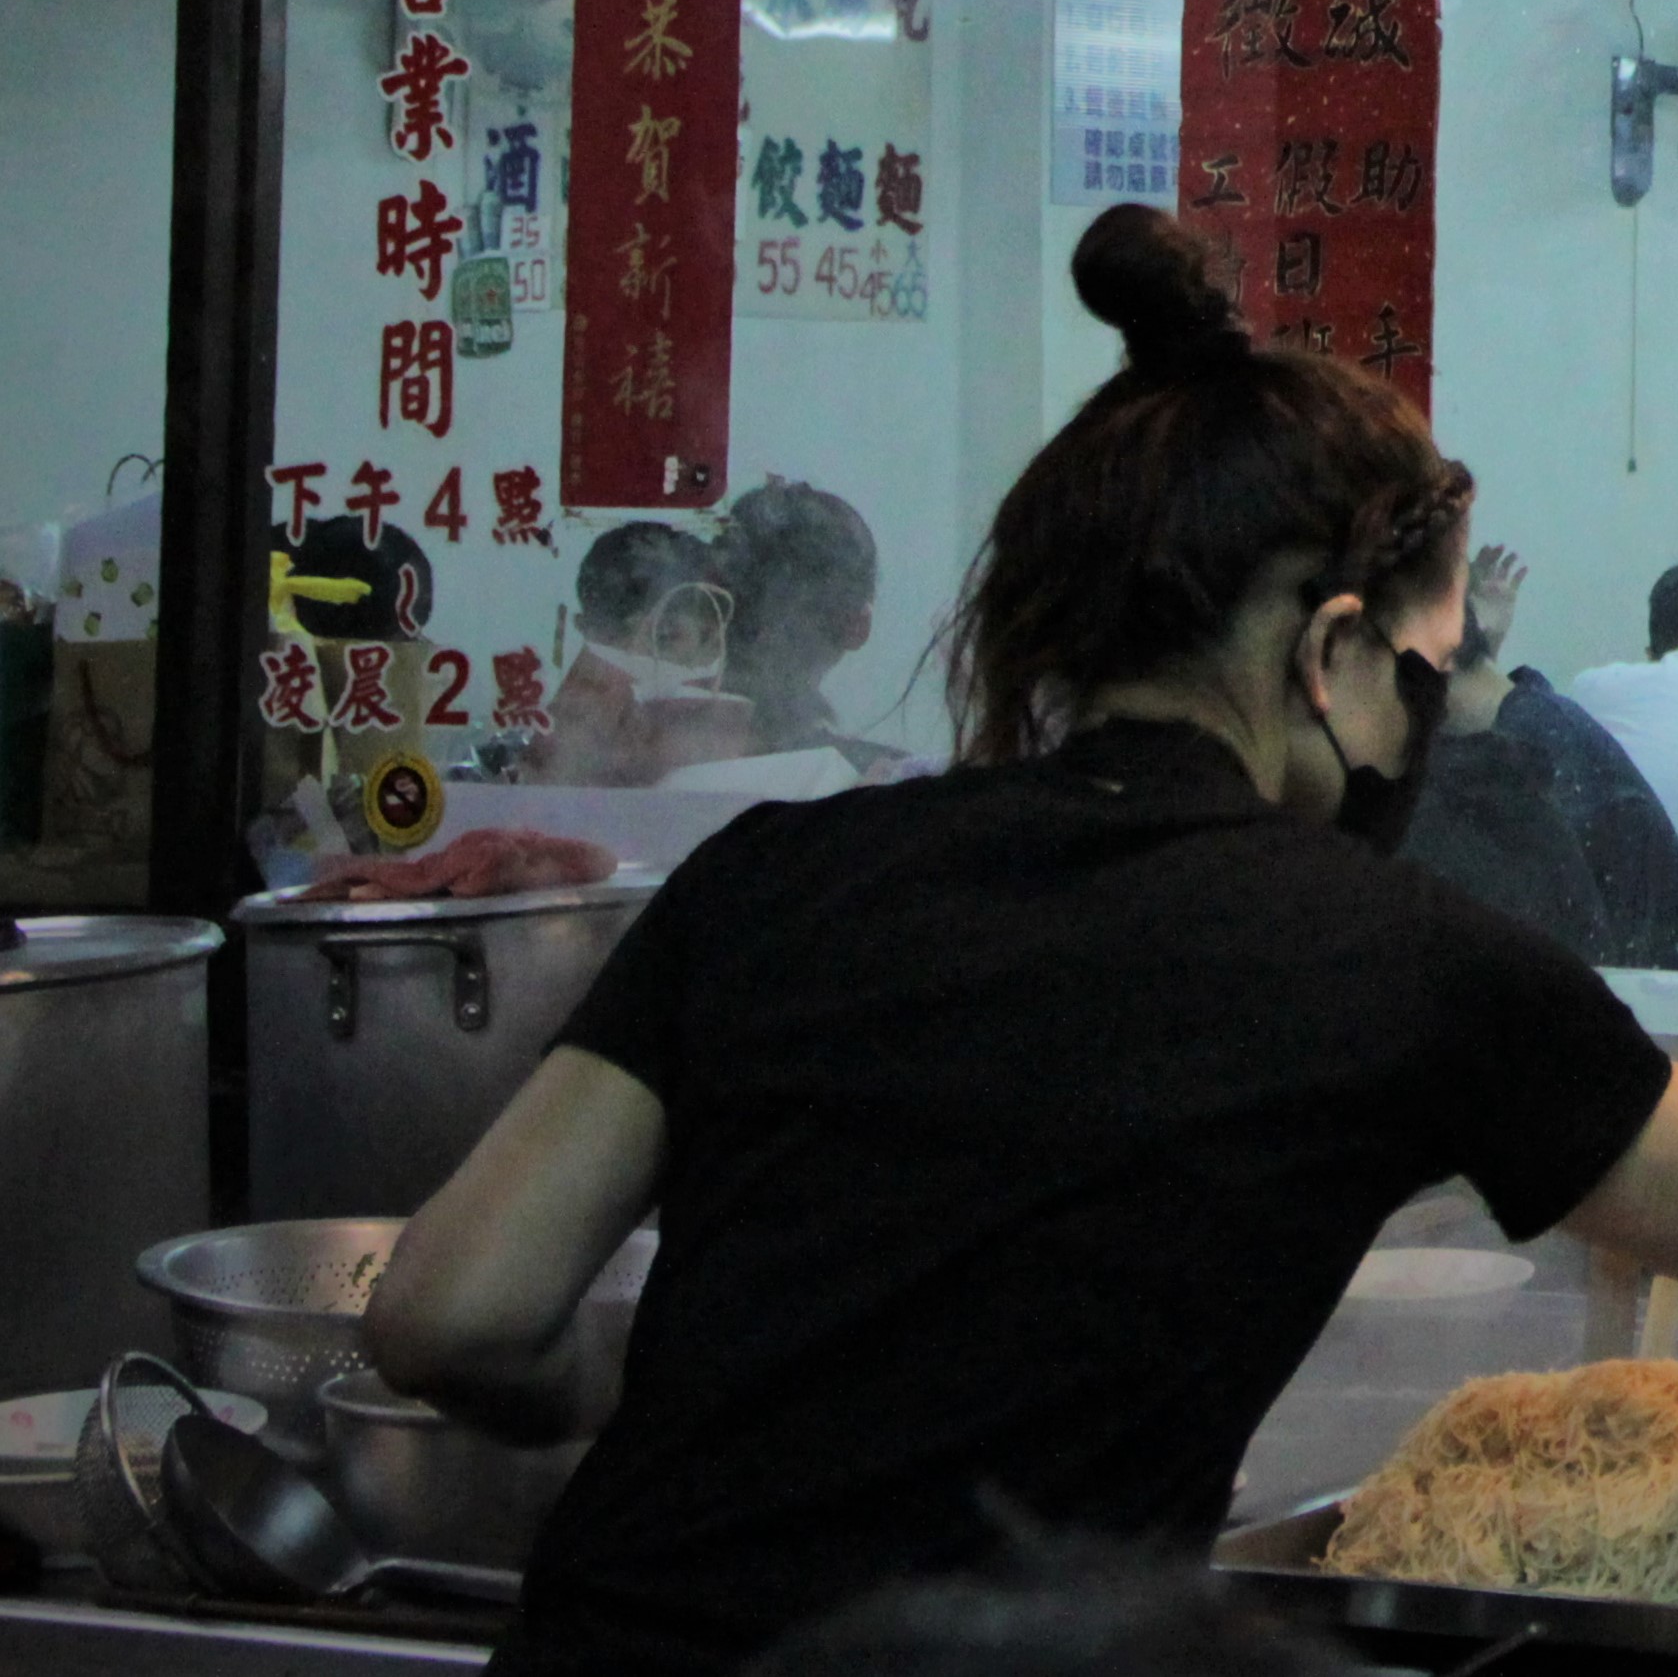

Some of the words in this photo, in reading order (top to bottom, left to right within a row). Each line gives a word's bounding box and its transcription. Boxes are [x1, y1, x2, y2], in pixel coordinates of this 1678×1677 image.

[757, 236, 800, 295] 55
[814, 245, 858, 301] 45
[1348, 140, 1425, 380] 助手
[266, 460, 556, 546] 下午4點
[259, 643, 555, 732] 凌晨2點
